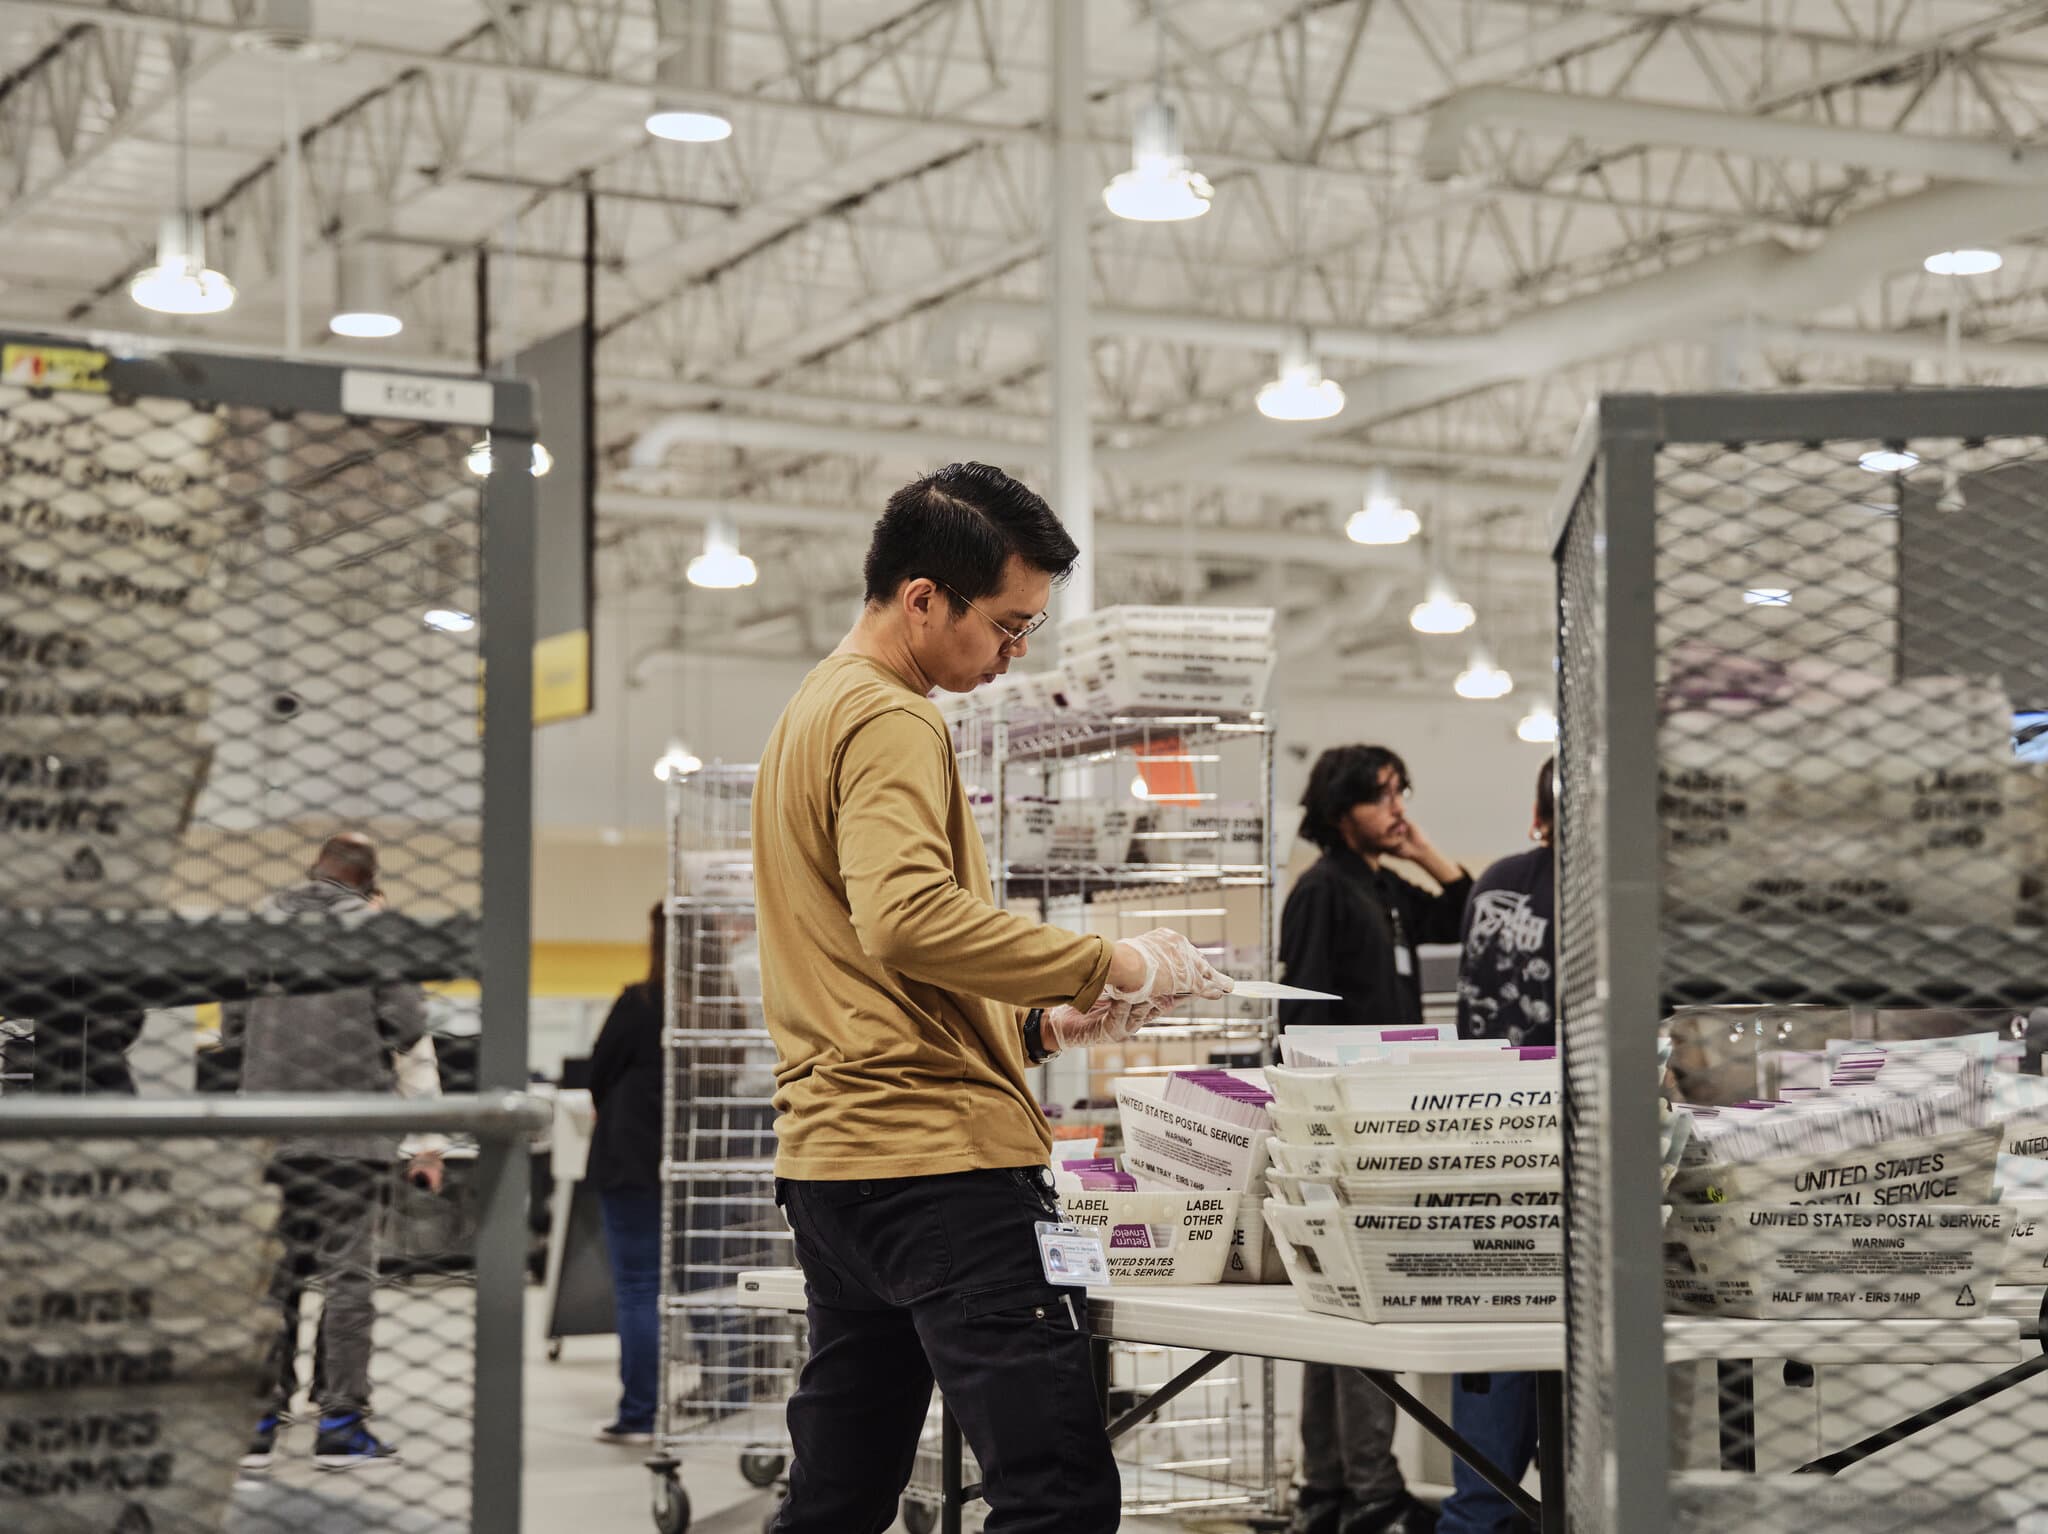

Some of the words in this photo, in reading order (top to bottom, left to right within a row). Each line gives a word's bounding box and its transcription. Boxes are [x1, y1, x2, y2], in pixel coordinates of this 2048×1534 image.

[1508, 1090, 1561, 1106] STA
[1144, 1105, 1174, 1125] STATES
[1175, 1115, 1208, 1136] POSTAL
[1210, 1127, 1249, 1149] SERVICE
[1354, 1119, 1420, 1134] UNITED
[1425, 1116, 1494, 1132] STATES
[1165, 1130, 1193, 1147] WARNING
[1356, 1156, 1423, 1170] UNITED
[1428, 1155, 1496, 1170] STATES
[1156, 1166, 1172, 1178] TRAY
[1794, 1166, 1867, 1193] UNITED
[1873, 1154, 1944, 1180] STATES
[1873, 1176, 1959, 1206] SERVICE
[1067, 1200, 1109, 1211] LABEL
[1186, 1200, 1224, 1211] LABEL
[1413, 1193, 1501, 1208] UNITED
[1183, 1215, 1223, 1226] OTHER
[1355, 1216, 1422, 1229] UNITED
[1427, 1215, 1496, 1230] STATES
[1749, 1212, 1808, 1227] UNITED
[1813, 1213, 1872, 1228] STATES
[1876, 1213, 1934, 1228] POSTAL
[1939, 1214, 2001, 1229] SERVICE
[1188, 1230, 1213, 1241] END
[1116, 1238, 1149, 1247] Return
[1473, 1239, 1536, 1251] WARNING
[1852, 1238, 1905, 1249] WARNING
[1106, 1258, 1137, 1266] NITED
[1138, 1258, 1174, 1266] STATES
[1383, 1296, 1417, 1307] HALF
[1421, 1296, 1442, 1306] MM
[1447, 1296, 1481, 1306] TRAY
[1492, 1295, 1521, 1306] EIRS
[1525, 1295, 1557, 1305] 74HP
[1772, 1292, 1802, 1303] HALF
[1805, 1293, 1823, 1303] MM
[1827, 1292, 1856, 1304] TRAY
[1865, 1293, 1890, 1303] EIRS
